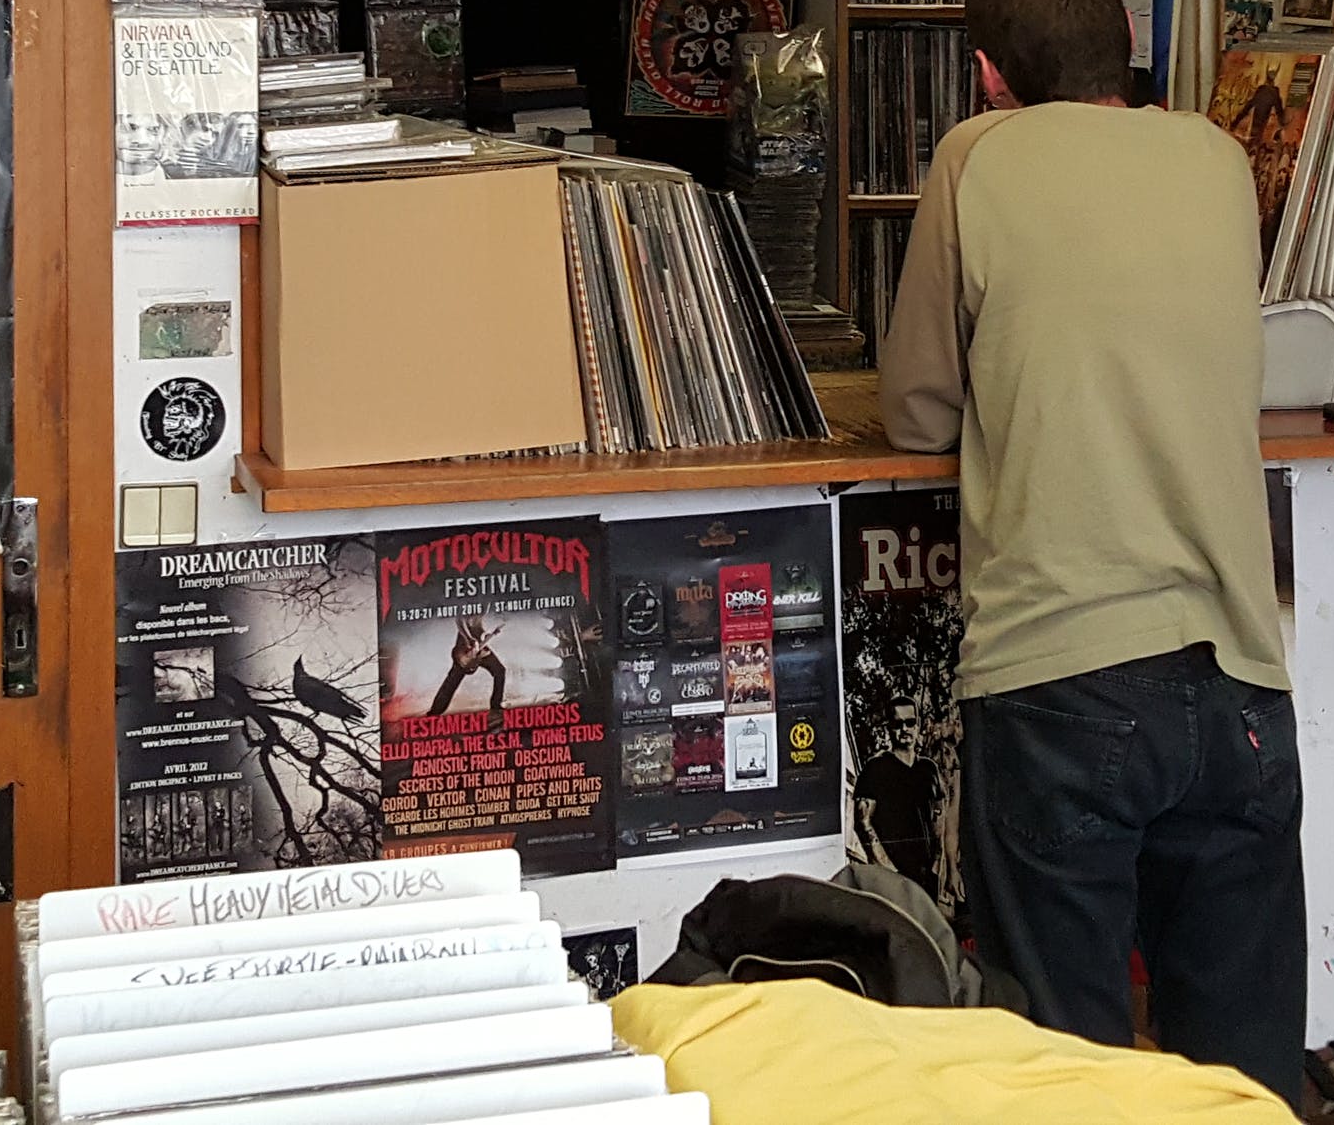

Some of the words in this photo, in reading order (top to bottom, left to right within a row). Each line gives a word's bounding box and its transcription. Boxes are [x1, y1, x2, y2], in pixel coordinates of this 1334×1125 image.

[121, 25, 193, 41] NIRVANA
[137, 42, 168, 58] THE
[173, 42, 232, 57] SOUND
[122, 60, 144, 76] OF
[135, 210, 185, 219] CLASSIC
[190, 209, 220, 217] ROCK
[225, 208, 255, 216] READ
[160, 544, 327, 577] DREAMCATCHER
[179, 574, 224, 588] Emerging
[225, 574, 250, 584] From
[380, 531, 590, 623] MOTOCULTOR
[444, 573, 530, 598] FESTIVAL
[462, 603, 482, 615] 2016
[402, 711, 489, 739] TESTAMENT
[503, 703, 580, 730] NEUROSIS
[413, 739, 454, 758] BIAFRA
[464, 735, 484, 752] THE
[533, 728, 566, 747] DYING
[569, 724, 604, 742] FETUS
[412, 757, 467, 777] AGNOSTIC
[470, 752, 506, 772] FRONT
[515, 746, 571, 766] OBSCURA
[399, 776, 444, 794] SECRETS
[447, 775, 460, 789] OF
[462, 773, 481, 788] THE
[484, 769, 515, 785] MOON
[524, 763, 585, 781] GOATWHORE
[382, 795, 417, 812] GOROD
[427, 791, 466, 807] VEKTOR
[475, 786, 511, 802] CONAN
[517, 782, 546, 799] PIPES
[548, 780, 568, 795] AND
[572, 777, 601, 792] PINTS
[97, 892, 181, 934] RARE
[189, 879, 270, 928] HEAVY
[279, 867, 353, 923] METAL
